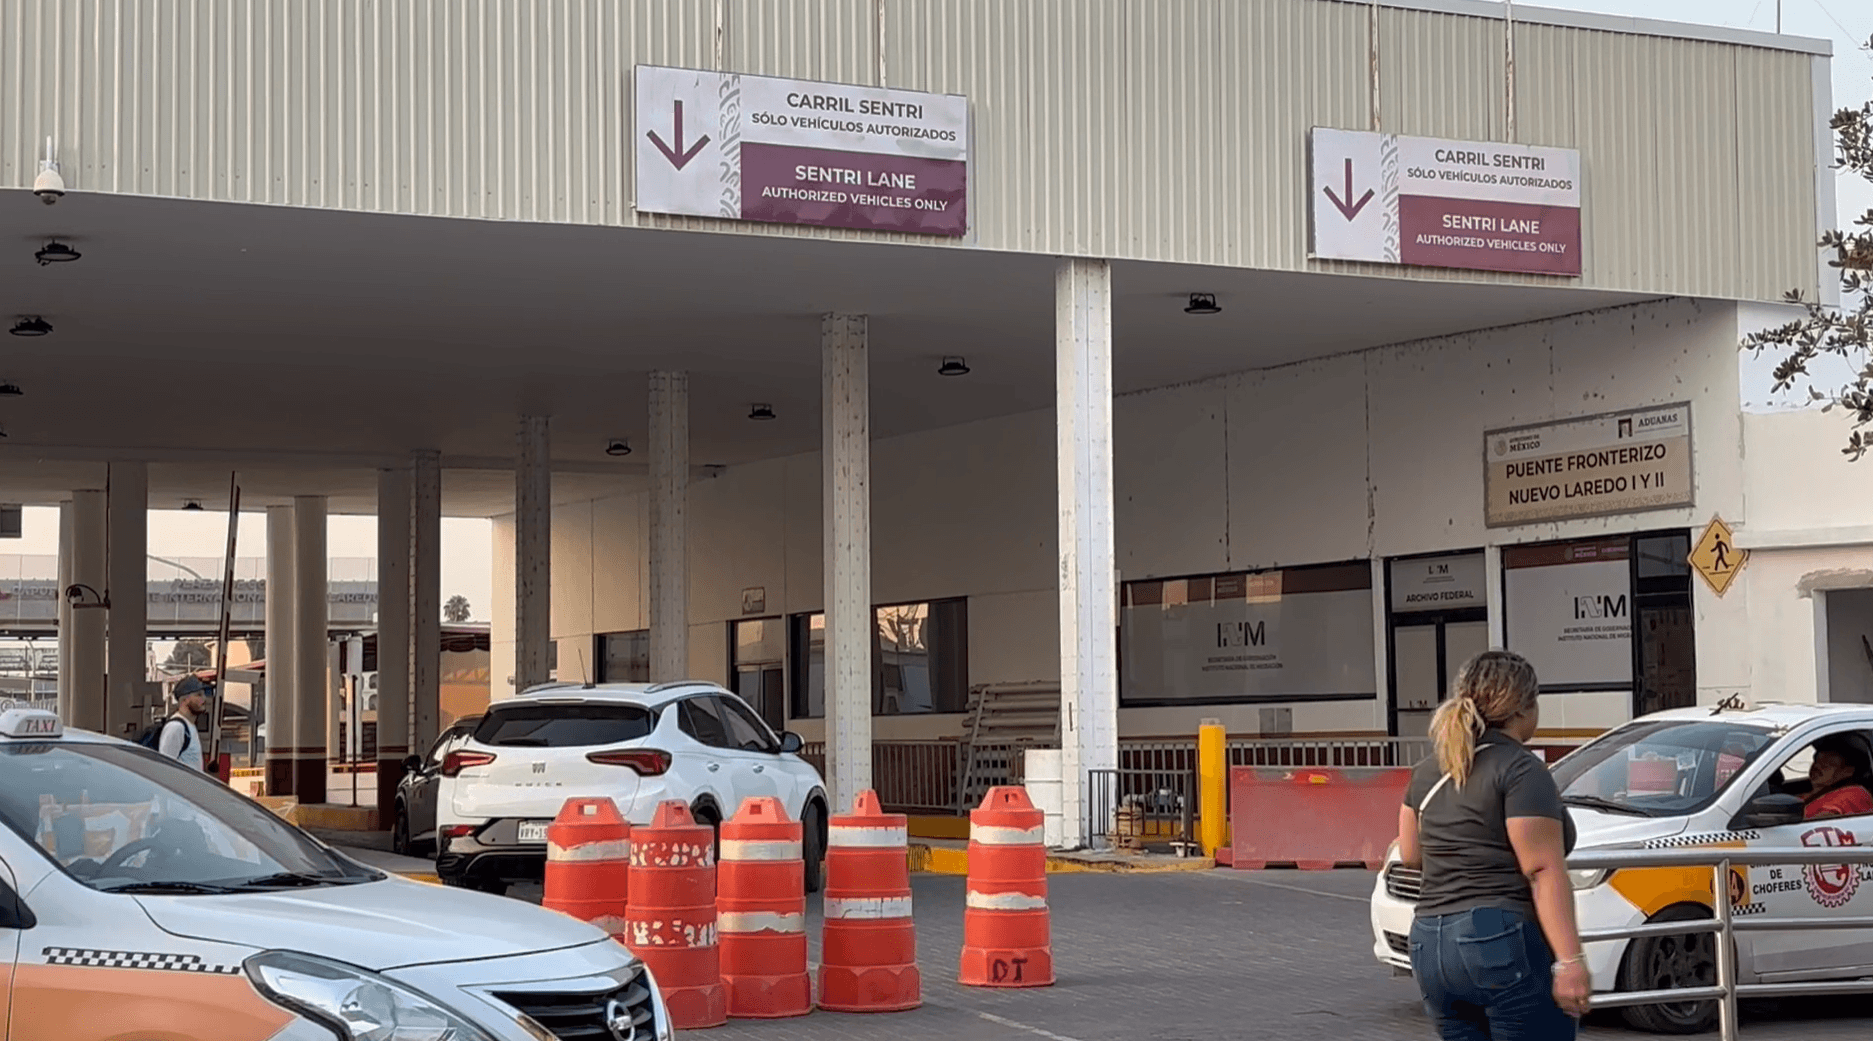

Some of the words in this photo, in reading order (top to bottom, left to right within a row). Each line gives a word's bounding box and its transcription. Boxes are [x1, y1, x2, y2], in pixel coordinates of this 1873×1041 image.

[786, 92, 855, 114] CARRIL
[858, 99, 924, 120] SENTRI
[751, 111, 788, 126] SÓLO
[790, 114, 864, 134] VEHÍCULOS
[866, 123, 957, 142] AUTORIZADOS
[1434, 149, 1490, 167] CARRIL
[1492, 154, 1546, 171] SENTRI
[795, 165, 862, 186] SENTRI
[867, 170, 916, 190] LANE
[1407, 166, 1437, 180] SÓLO
[1438, 168, 1498, 185] VEHÍCULOS
[1499, 175, 1573, 191] AUTORIZADOS
[761, 185, 847, 203] AUTHORIZED
[850, 192, 912, 209] VEHICLES
[914, 198, 949, 212] ONLY
[1442, 214, 1497, 231] SENTRI
[1500, 218, 1540, 235] LANE
[1416, 233, 1485, 248] AUTHORIZED
[1486, 238, 1537, 252] VEHICLES
[1538, 242, 1567, 255] ONLY
[1638, 413, 1678, 428] ADUANAS
[1509, 441, 1541, 452] MÉXICO
[1506, 457, 1564, 479] PUENTE
[1567, 443, 1667, 471] FRONTERIZO
[1509, 484, 1560, 505] NUEVO
[1564, 475, 1628, 499] LAREDO
[1631, 477, 1637, 491] I
[1639, 474, 1652, 489] Y
[1655, 471, 1665, 488] II
[1406, 591, 1439, 603] ARCHIVO
[1440, 589, 1475, 601] FEDERAL
[25, 719, 57, 733] TAXI
[1770, 869, 1783, 880] DE
[1752, 879, 1803, 896] CHOFERES
[992, 958, 1028, 983] DT
